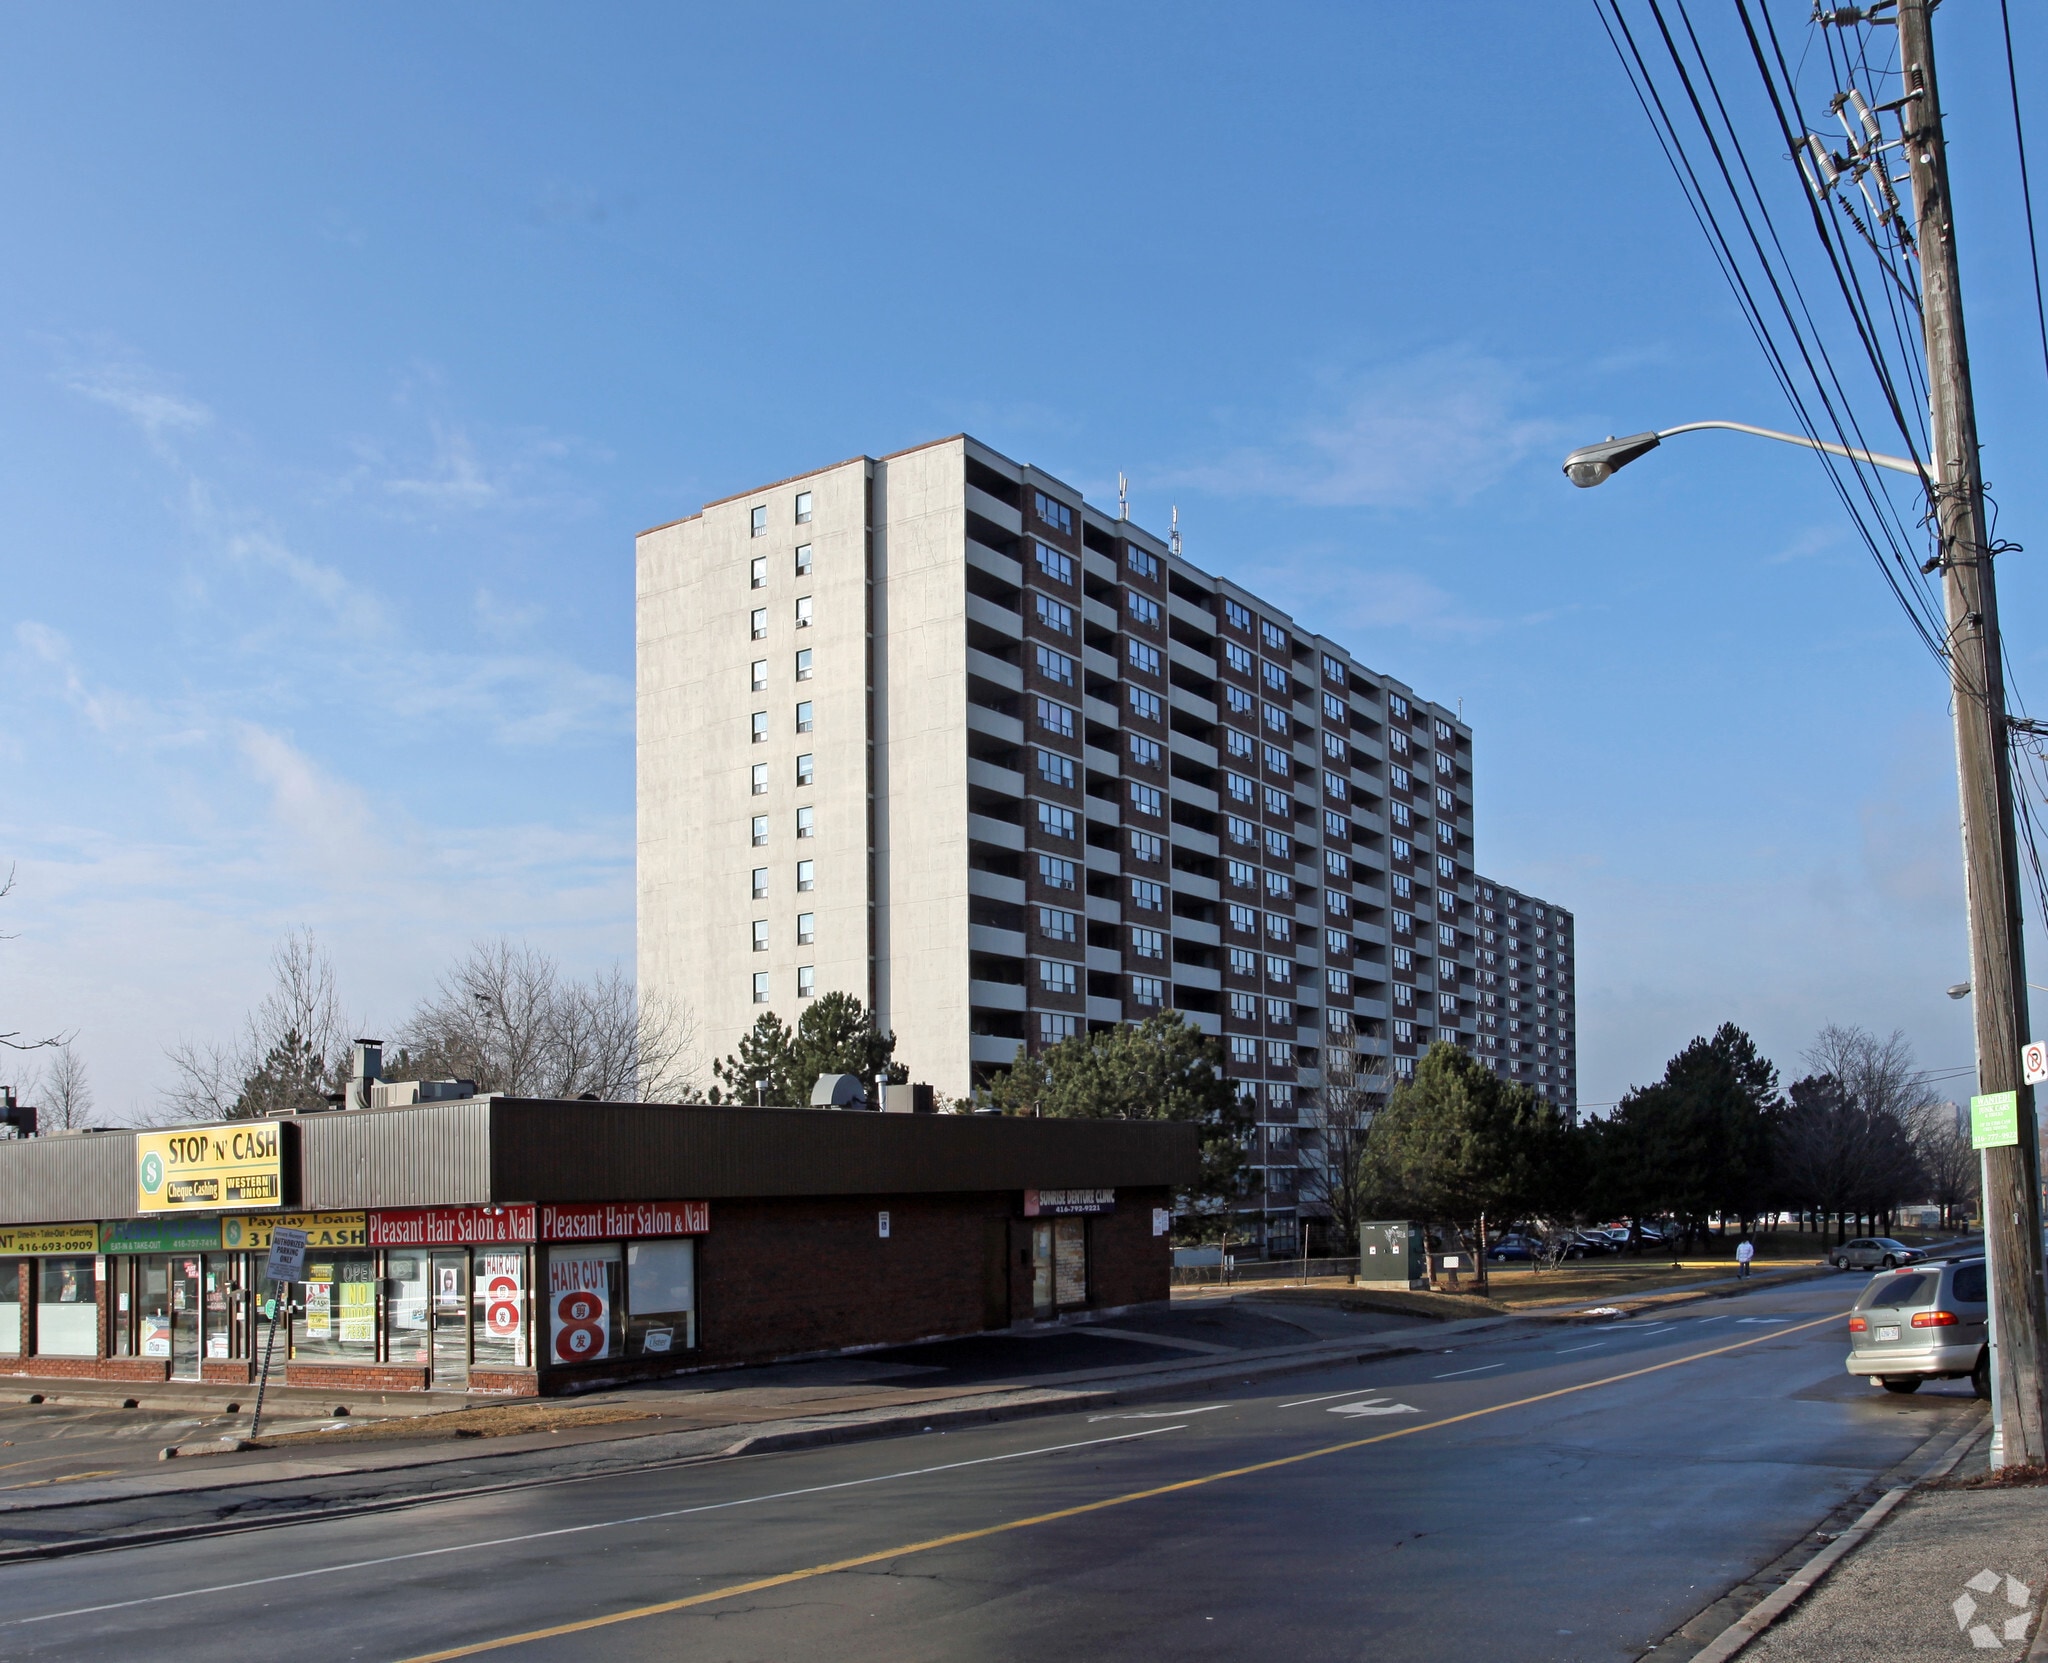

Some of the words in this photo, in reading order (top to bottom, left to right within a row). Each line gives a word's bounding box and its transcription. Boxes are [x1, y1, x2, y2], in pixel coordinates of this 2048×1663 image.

[1977, 1094, 2010, 1105] WANTED!
[1995, 1104, 2010, 1112] CARS
[169, 1136, 208, 1164] STOP
[233, 1130, 277, 1160] CASH
[226, 1176, 268, 1189] WESTERN
[168, 1182, 192, 1201] Cheque
[194, 1181, 218, 1200] Cashing
[240, 1187, 268, 1198] UNION
[1040, 1190, 1066, 1206] SUNRISE
[1067, 1189, 1094, 1205] DENTURE
[1096, 1188, 1115, 1204] CLINIC
[248, 1216, 306, 1228] Payday
[313, 1214, 364, 1224] Loans
[369, 1213, 423, 1243] Pleasant
[427, 1212, 455, 1242] Hair
[458, 1210, 494, 1241] Salon
[497, 1222, 505, 1240] &
[509, 1208, 536, 1239] Nail
[543, 1207, 602, 1238] Pleasant
[606, 1205, 634, 1235] Hair
[637, 1204, 671, 1234] Salon
[675, 1215, 682, 1232] &
[685, 1202, 709, 1231] Nail
[41, 1229, 65, 1238] Take-Out
[70, 1228, 93, 1238] Catering
[306, 1229, 364, 1245] CASH
[18, 1241, 93, 1251] 416-693-0909
[110, 1242, 128, 1250] EAT-IN
[134, 1241, 160, 1249] TAKE-OUT
[173, 1239, 217, 1247] 416-757-7414
[274, 1237, 304, 1248] AUTHORIZED
[277, 1246, 299, 1256] PARKING
[280, 1255, 293, 1263] ONLY
[487, 1254, 503, 1274] HAIR
[505, 1254, 519, 1274] CUT
[343, 1264, 374, 1282] OPEN
[551, 1261, 580, 1291] HAIR
[582, 1261, 604, 1289] CUT
[349, 1284, 367, 1305] NO
[346, 1324, 370, 1339] FEES!
[556, 1291, 604, 1362] 8
[576, 1335, 586, 1347] 发
